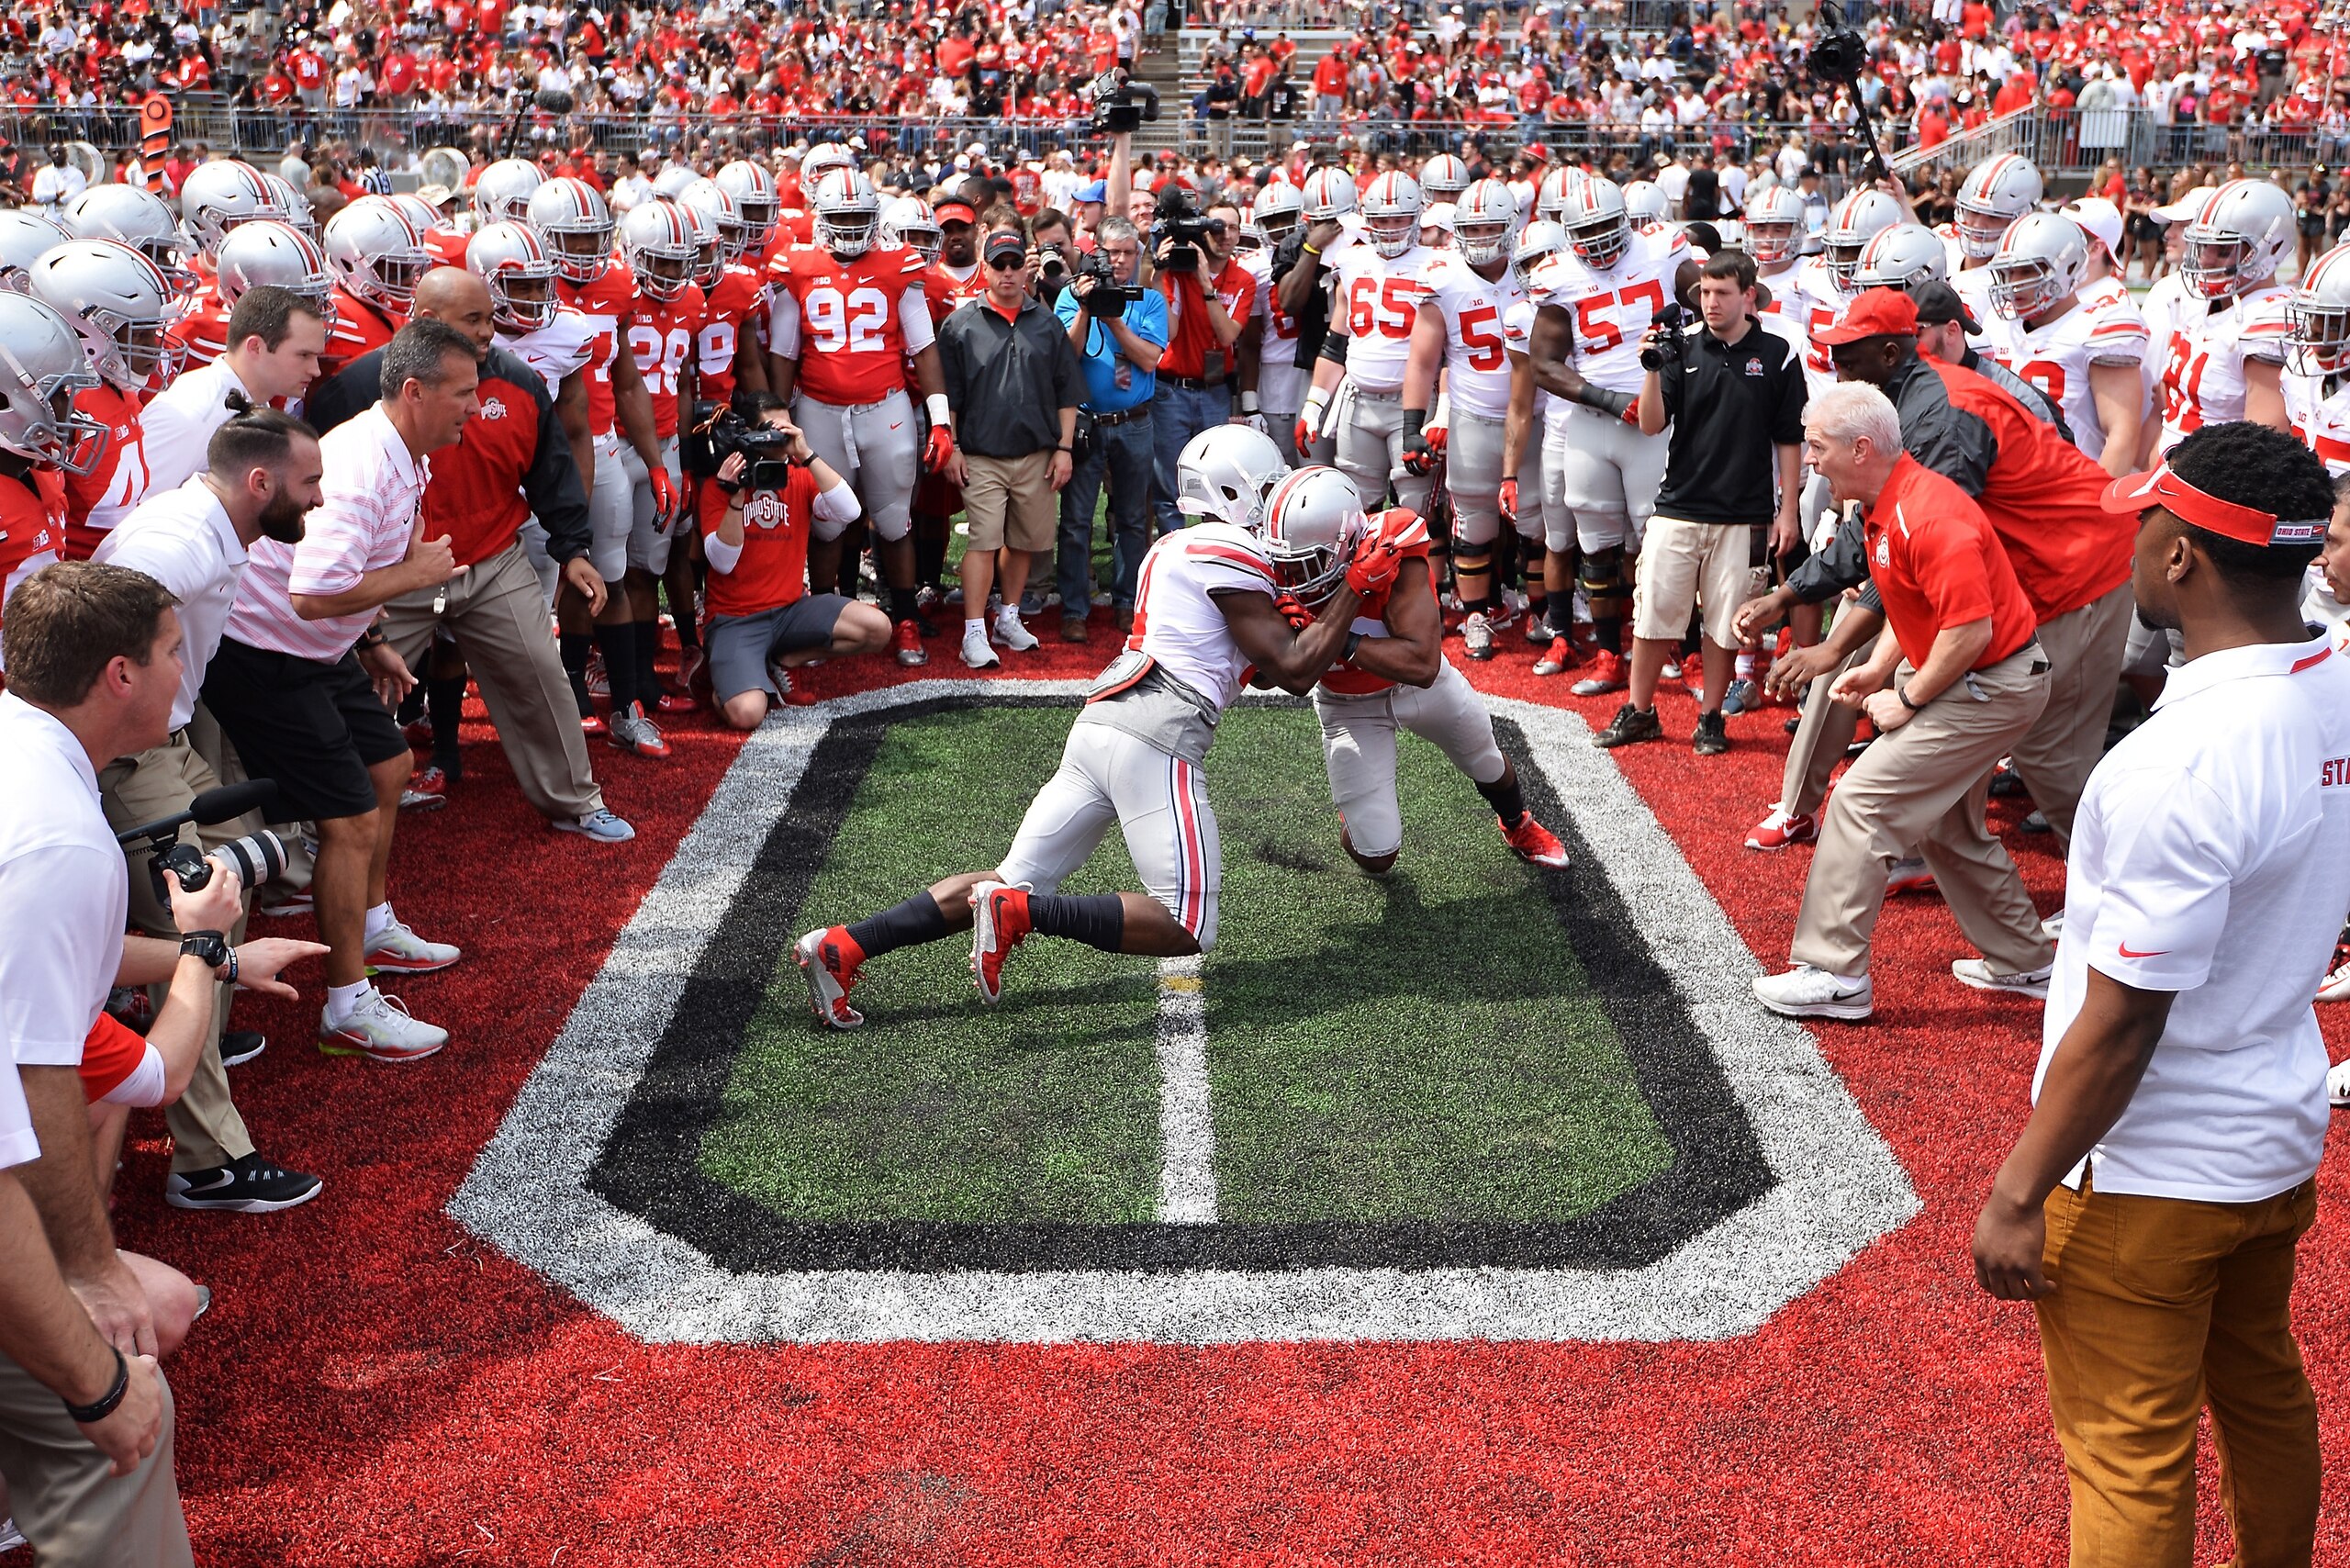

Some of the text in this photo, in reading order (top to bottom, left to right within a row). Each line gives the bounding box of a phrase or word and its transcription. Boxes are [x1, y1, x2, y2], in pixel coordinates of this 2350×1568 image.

[806, 287, 888, 353] 92
[1349, 277, 1419, 339] 65
[1459, 306, 1505, 371] 5
[1574, 279, 1664, 355] 57
[628, 325, 690, 396] 28
[744, 497, 789, 528] OHIO STATE
[2277, 528, 2311, 536] OHIO STATE
